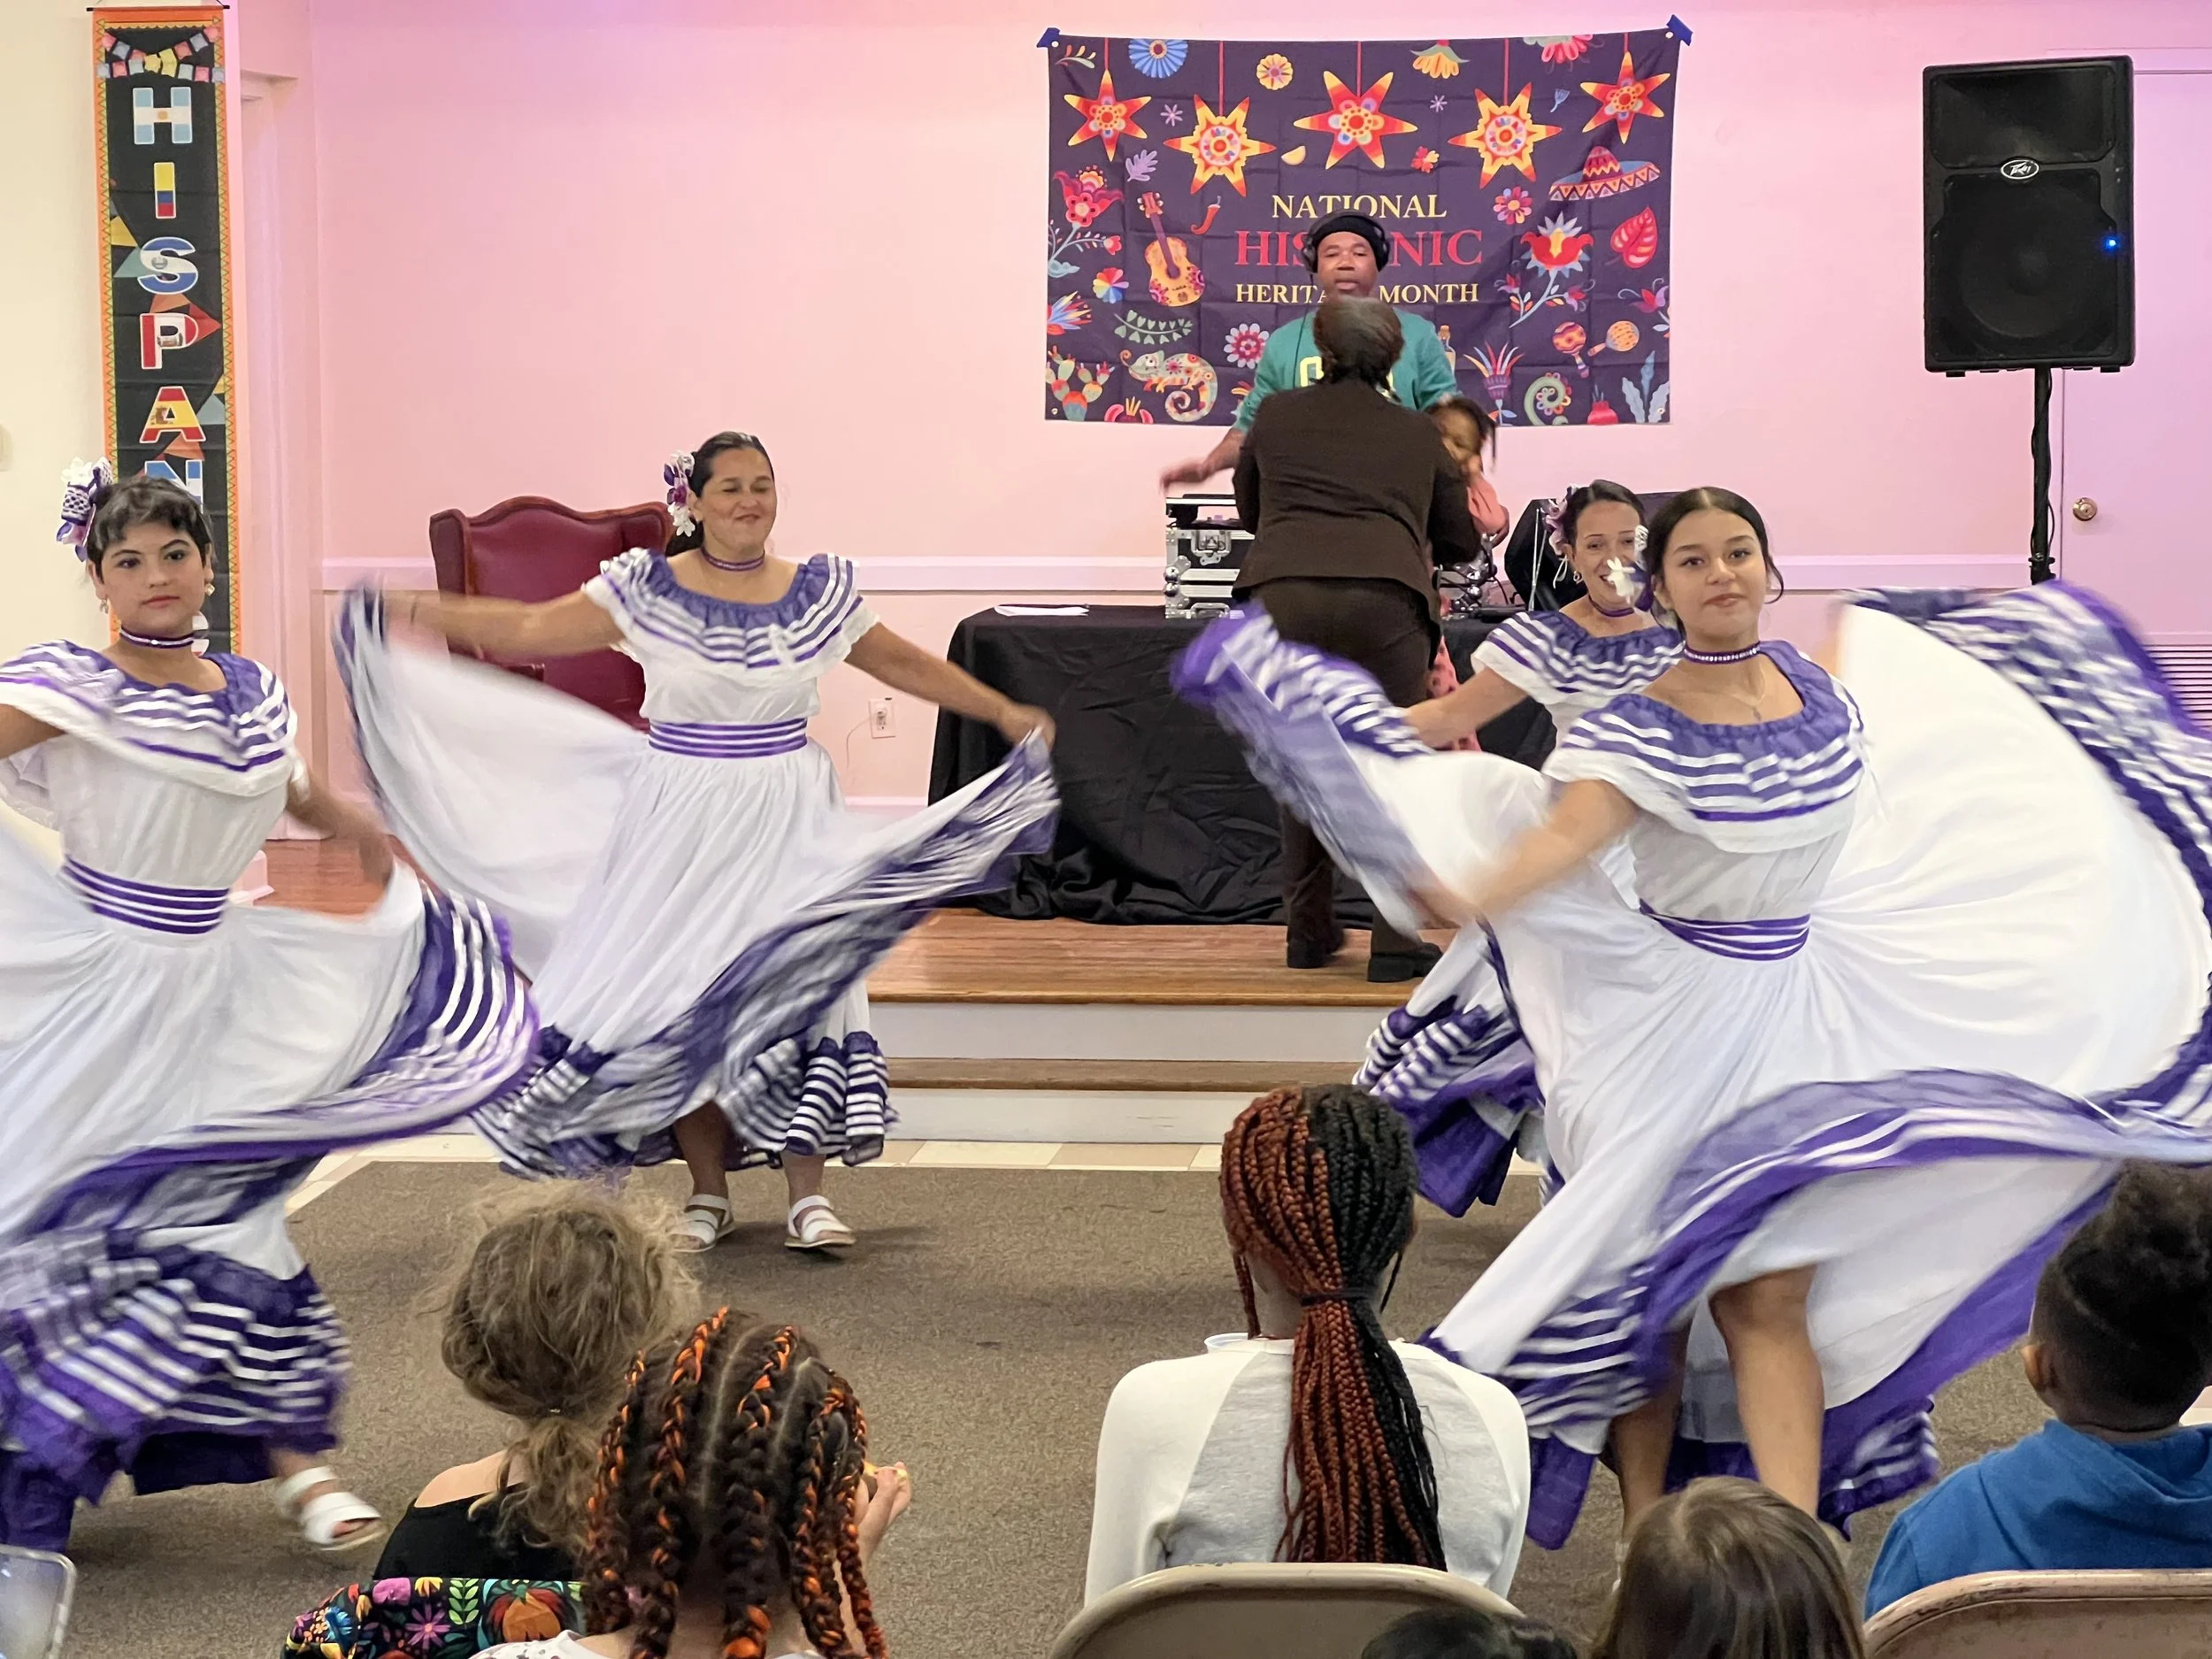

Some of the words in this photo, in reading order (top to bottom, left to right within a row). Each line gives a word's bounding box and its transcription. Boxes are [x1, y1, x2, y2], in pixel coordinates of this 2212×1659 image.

[1271, 194, 1447, 219] NATIONAL
[1234, 229, 1482, 266] HISNIC
[1379, 283, 1479, 303] MONTH
[133, 86, 209, 657] HISPAN
